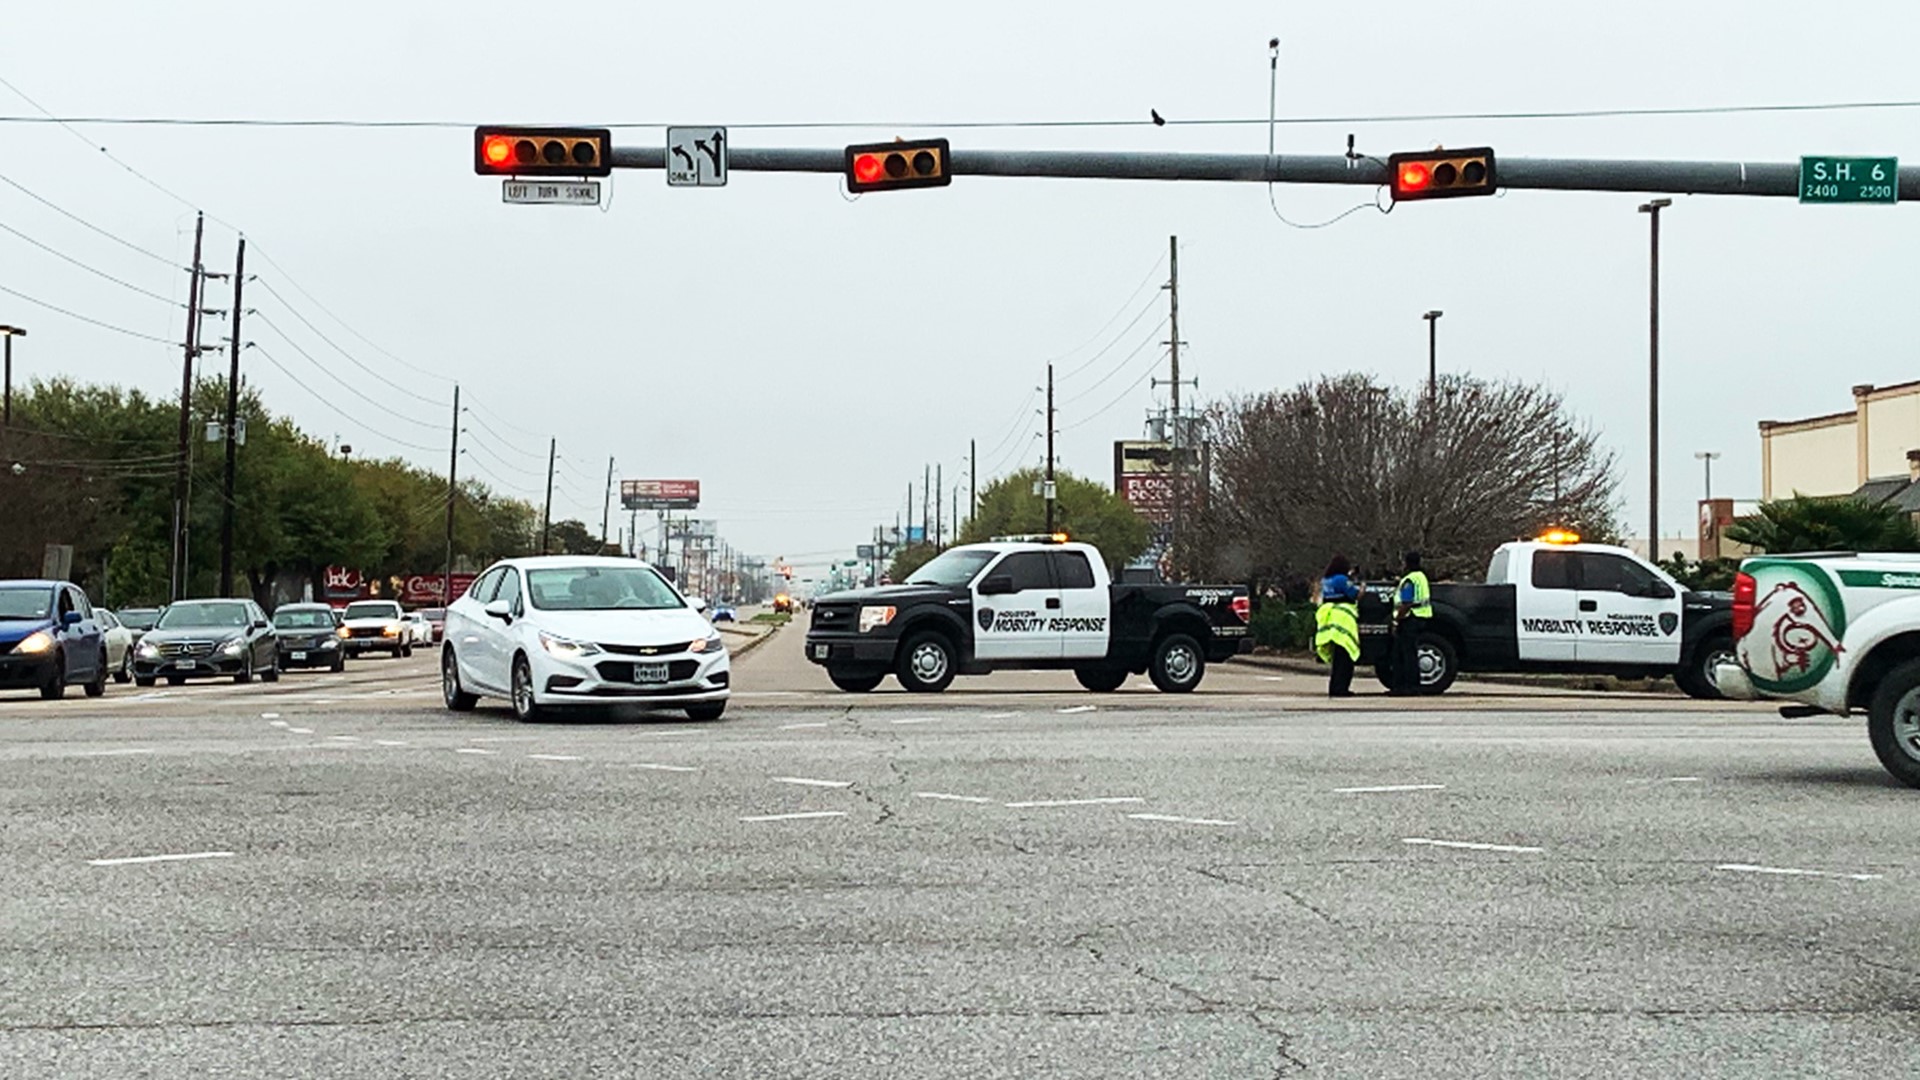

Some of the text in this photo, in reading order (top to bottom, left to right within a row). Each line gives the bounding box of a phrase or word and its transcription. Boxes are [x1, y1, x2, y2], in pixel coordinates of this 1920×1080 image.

[1813, 162, 1885, 181] S.H. 6
[508, 186, 527, 198] LEFT
[538, 186, 558, 198] TURN
[1806, 184, 1891, 198] 2400 2500
[1199, 595, 1219, 606] 911
[997, 610, 1037, 618] HOUSTON
[1607, 613, 1653, 621] HOUSTON
[994, 617, 1107, 633] MOBILITY RESPONSE
[1522, 619, 1659, 637] MOBILITY RESPONSE
